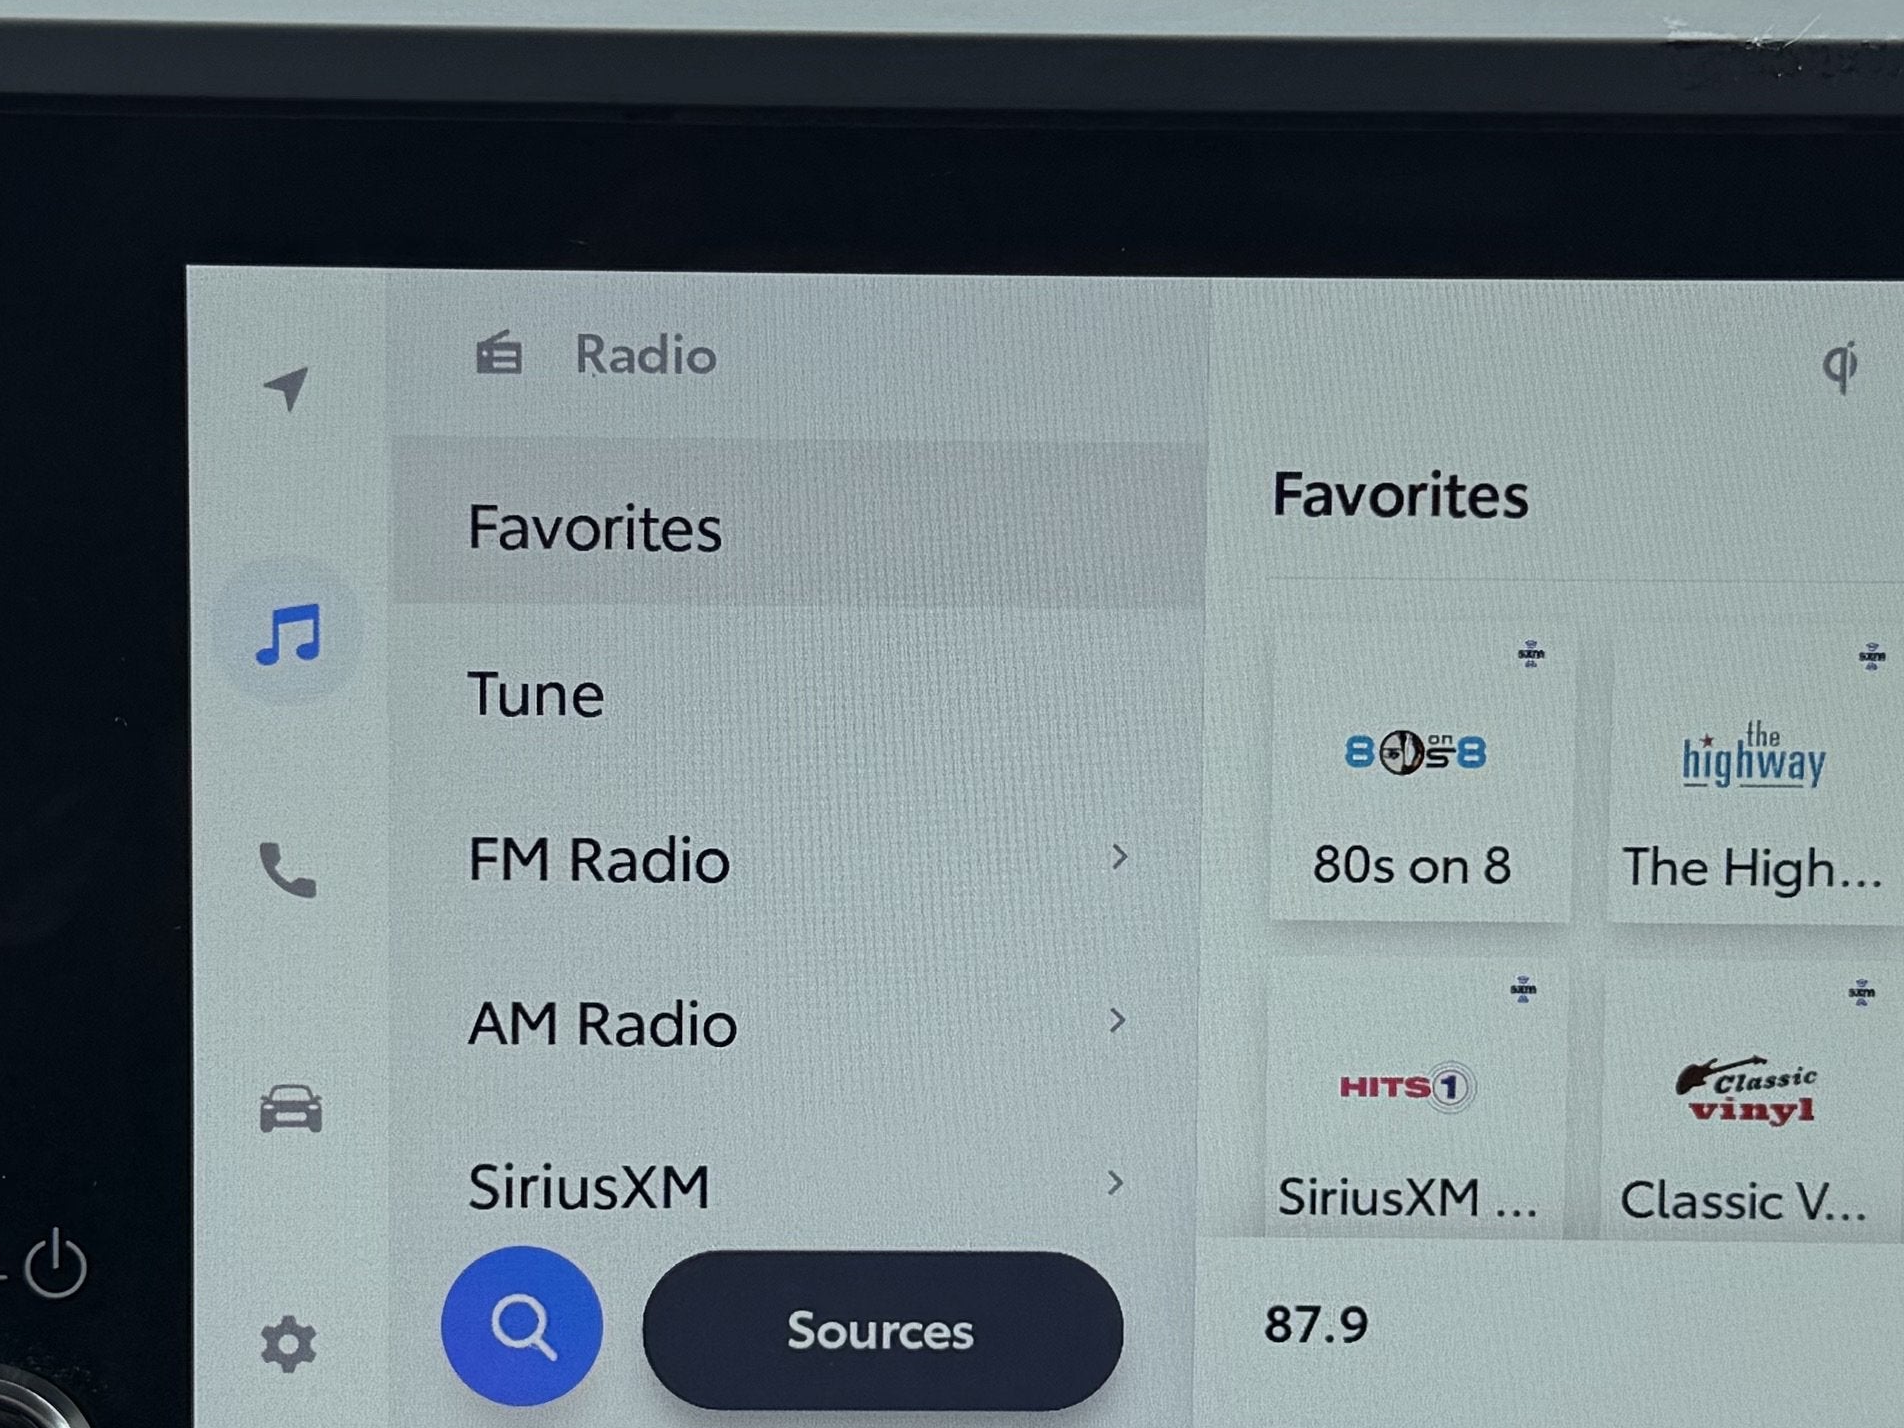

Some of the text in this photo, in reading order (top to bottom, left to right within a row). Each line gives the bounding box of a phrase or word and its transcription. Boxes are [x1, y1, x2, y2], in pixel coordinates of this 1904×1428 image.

[578, 333, 718, 379] Radio
[1276, 470, 1530, 520] Favorites
[471, 503, 723, 554] Favorites
[468, 672, 605, 719] Tune
[1457, 735, 1487, 769] 8
[1746, 719, 1781, 747] the
[1683, 739, 1826, 788] highway
[472, 835, 731, 885] FM Radio
[1314, 845, 1512, 886] 80s on 8
[1623, 846, 1882, 900] The High...
[468, 999, 738, 1049] AM Radio
[1340, 1076, 1432, 1099] HITS
[1714, 1066, 1819, 1095] Classic
[1688, 1096, 1815, 1127] vinyl
[470, 1163, 709, 1212] SiriusXM
[1280, 1178, 1479, 1218] SiriusXM
[1622, 1179, 1866, 1222] Classic V...
[789, 1311, 975, 1351] Sources
[1265, 1305, 1369, 1345] 87.9
